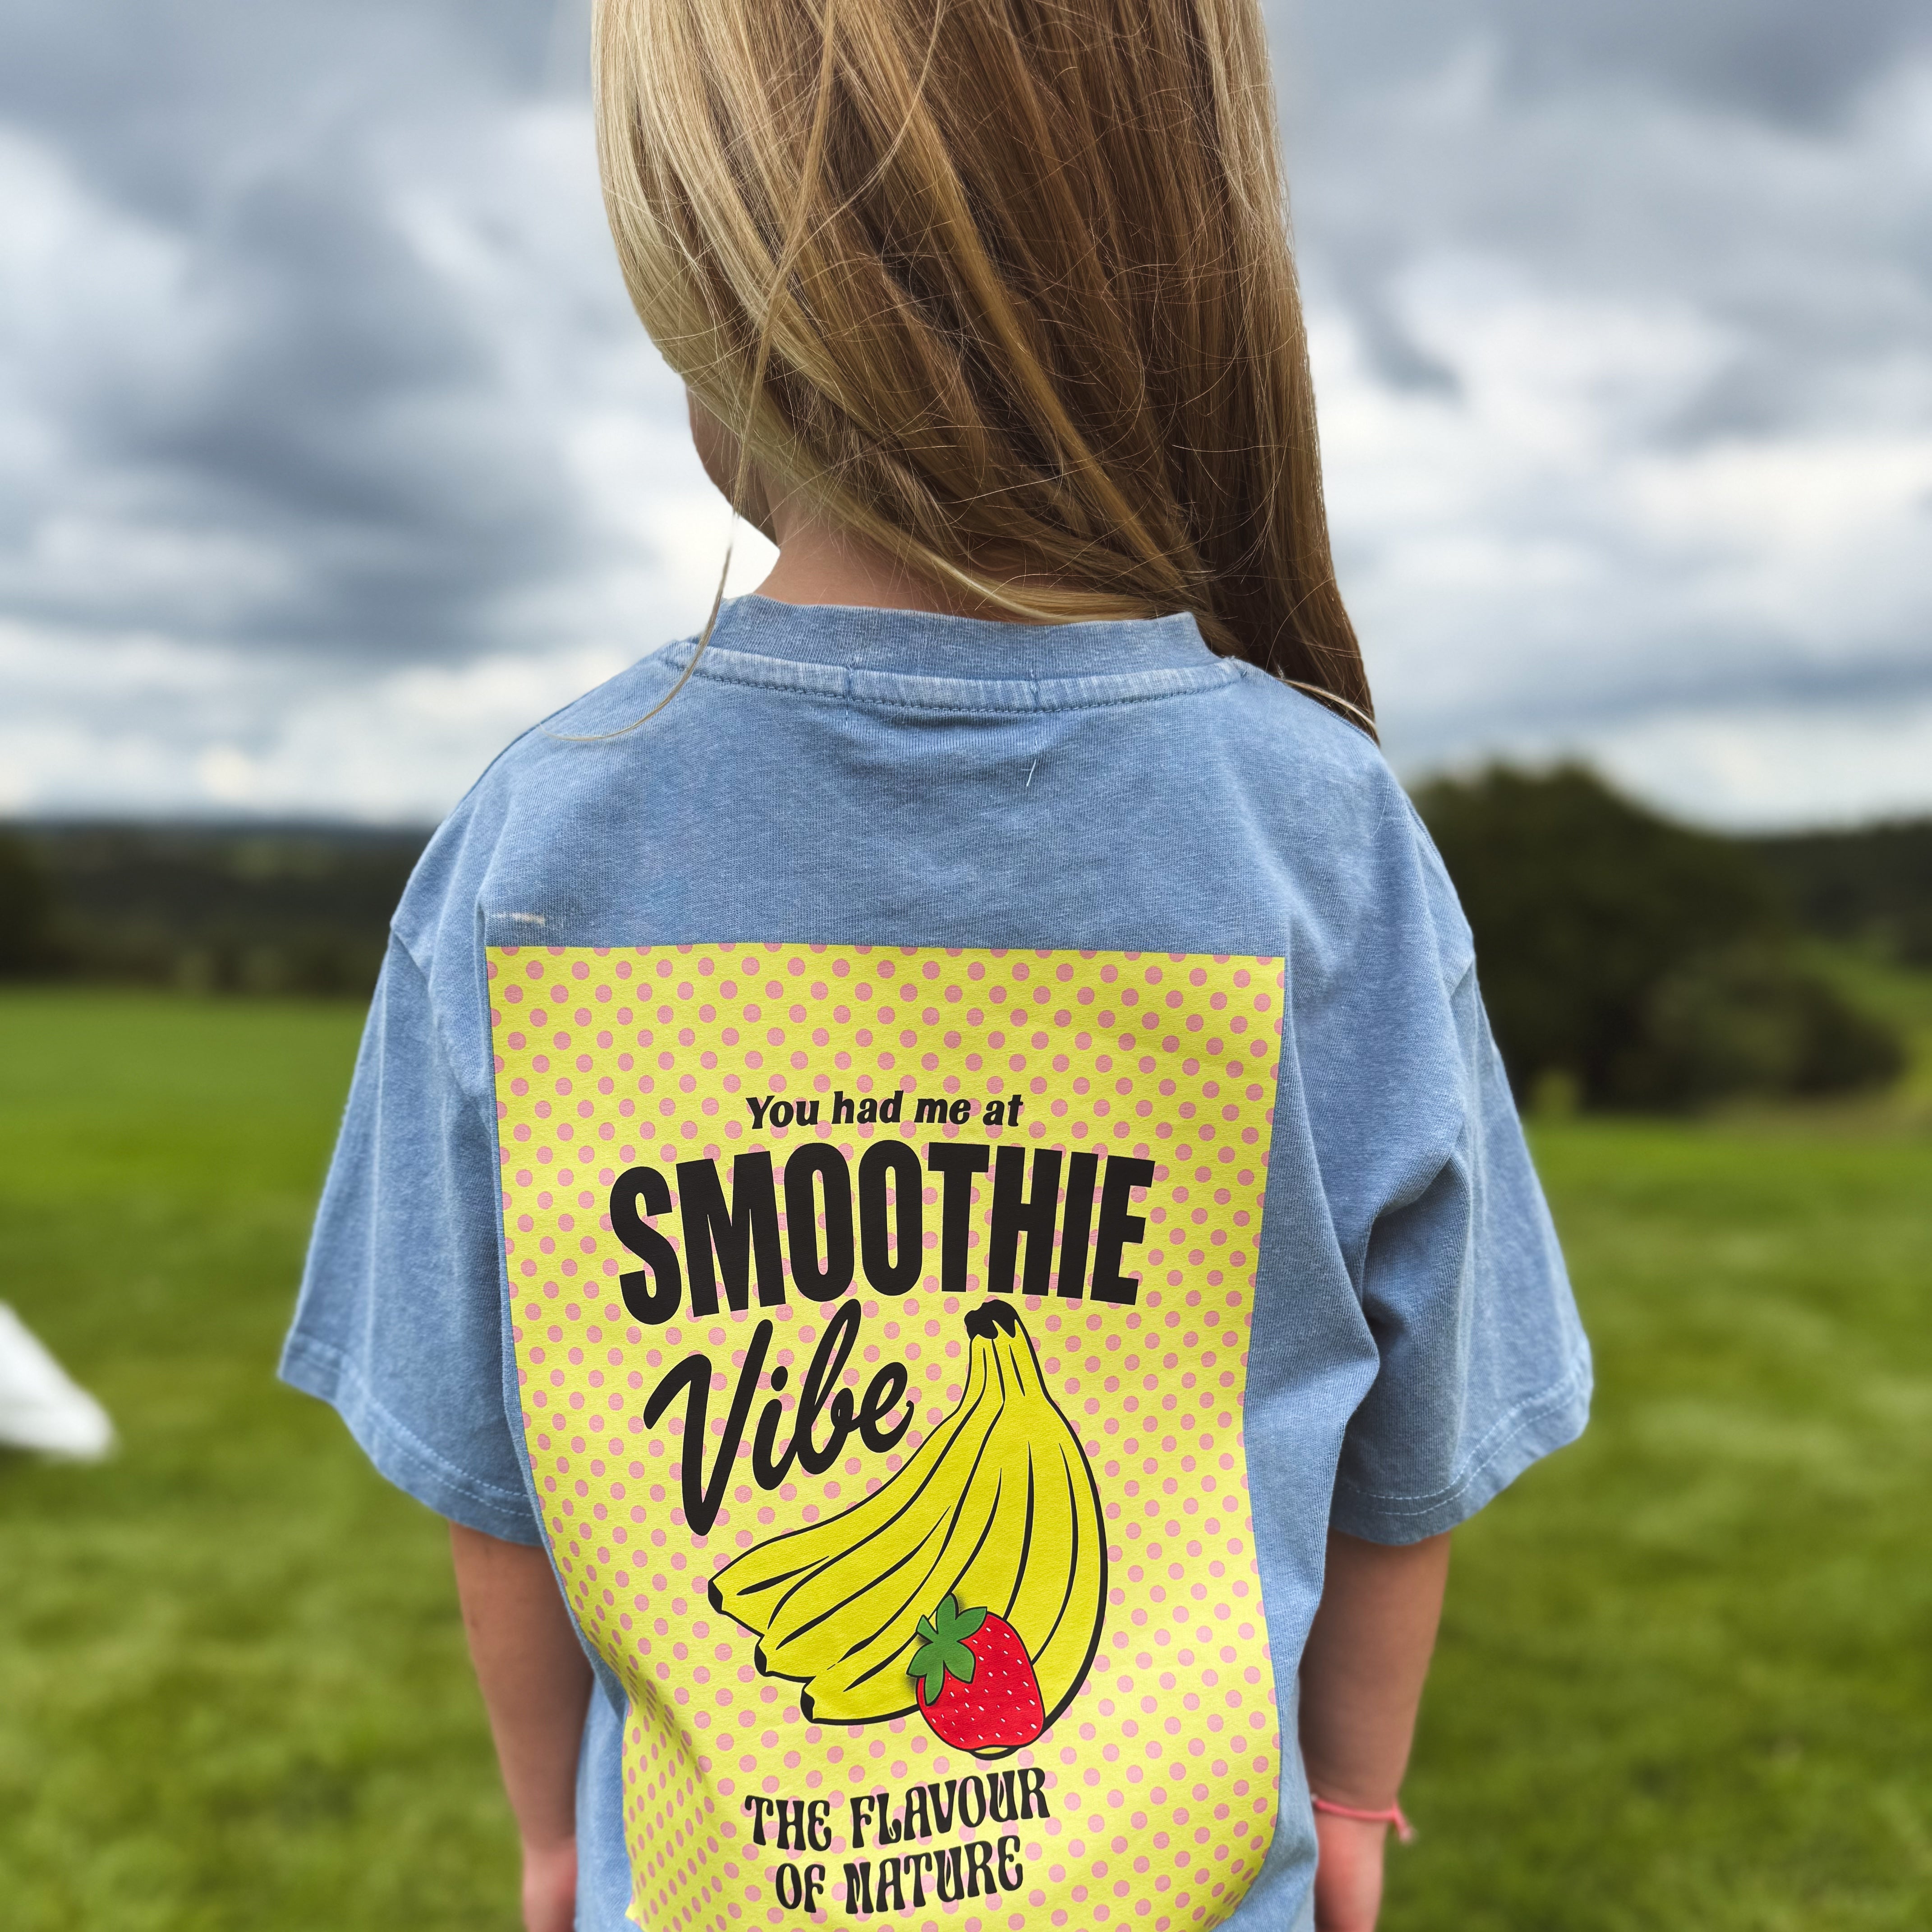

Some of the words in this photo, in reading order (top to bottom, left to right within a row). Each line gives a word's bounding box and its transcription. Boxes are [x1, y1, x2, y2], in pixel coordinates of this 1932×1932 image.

[745, 1095, 820, 1130] You
[831, 1090, 904, 1124] had
[914, 1098, 971, 1125] me
[983, 1094, 1024, 1127] at
[609, 1139, 1155, 1325] SMOOTHIE
[643, 1298, 915, 1536] Vibe
[744, 1794, 832, 1851] THE
[850, 1767, 1051, 1849] FLAVOUR
[775, 1863, 826, 1914] OF
[843, 1835, 1024, 1915] NATURE
